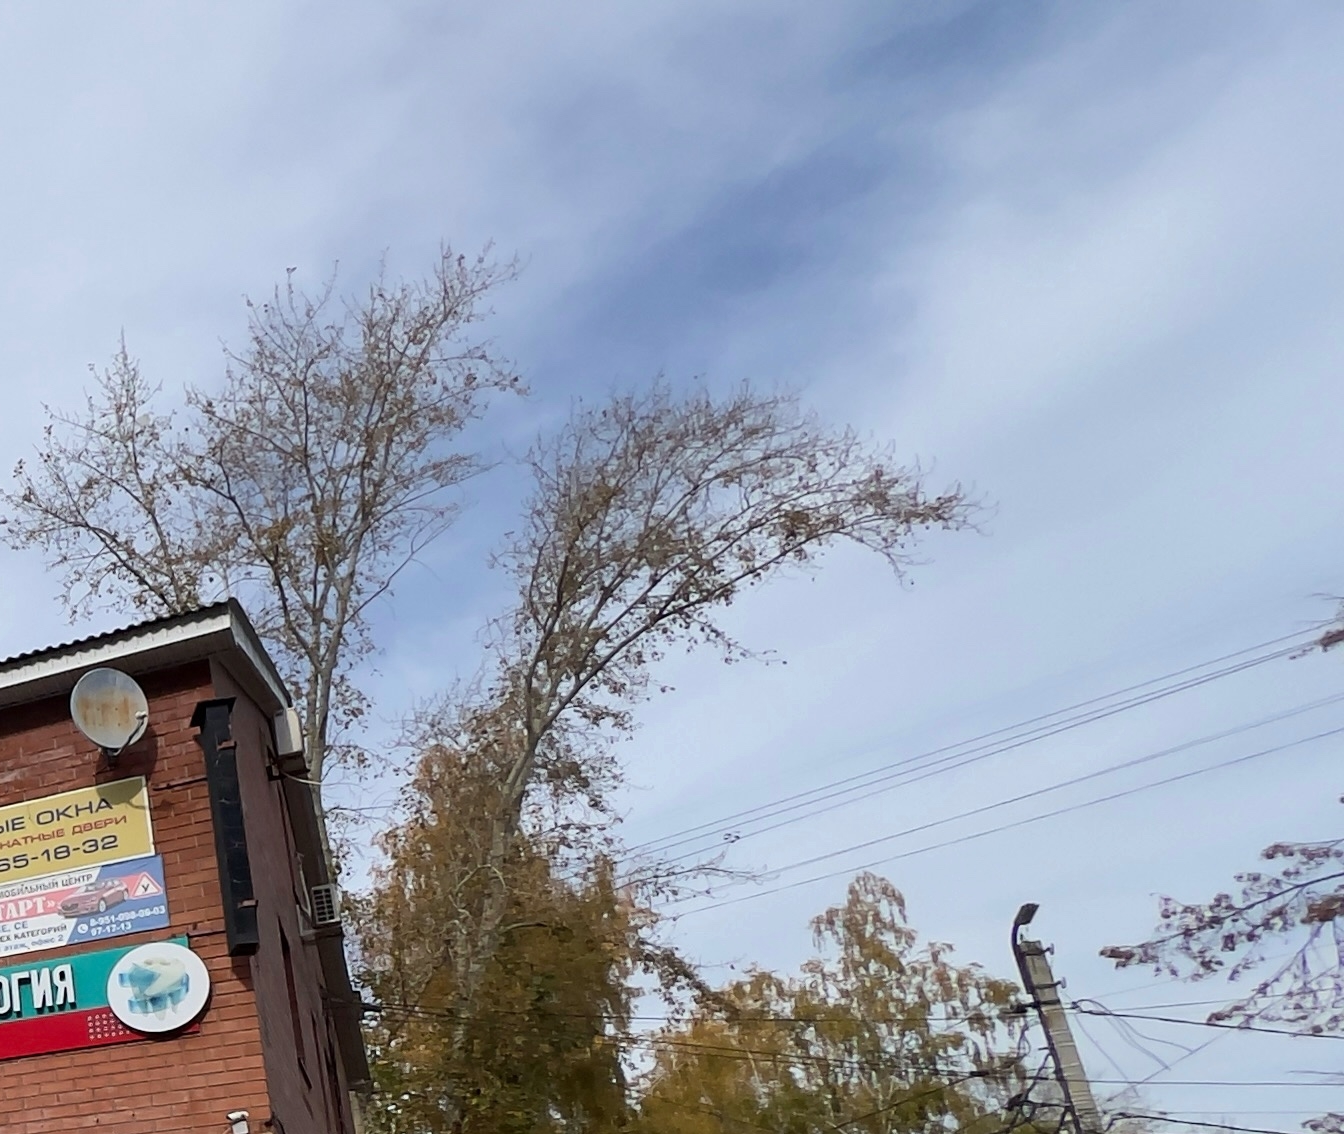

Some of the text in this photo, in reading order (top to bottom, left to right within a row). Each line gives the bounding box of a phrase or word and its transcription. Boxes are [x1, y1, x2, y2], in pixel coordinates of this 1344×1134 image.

[35, 797, 113, 826] ОКНА
[71, 815, 128, 836] ДВЕРИ
[61, 873, 93, 889] ЦЕНТР
